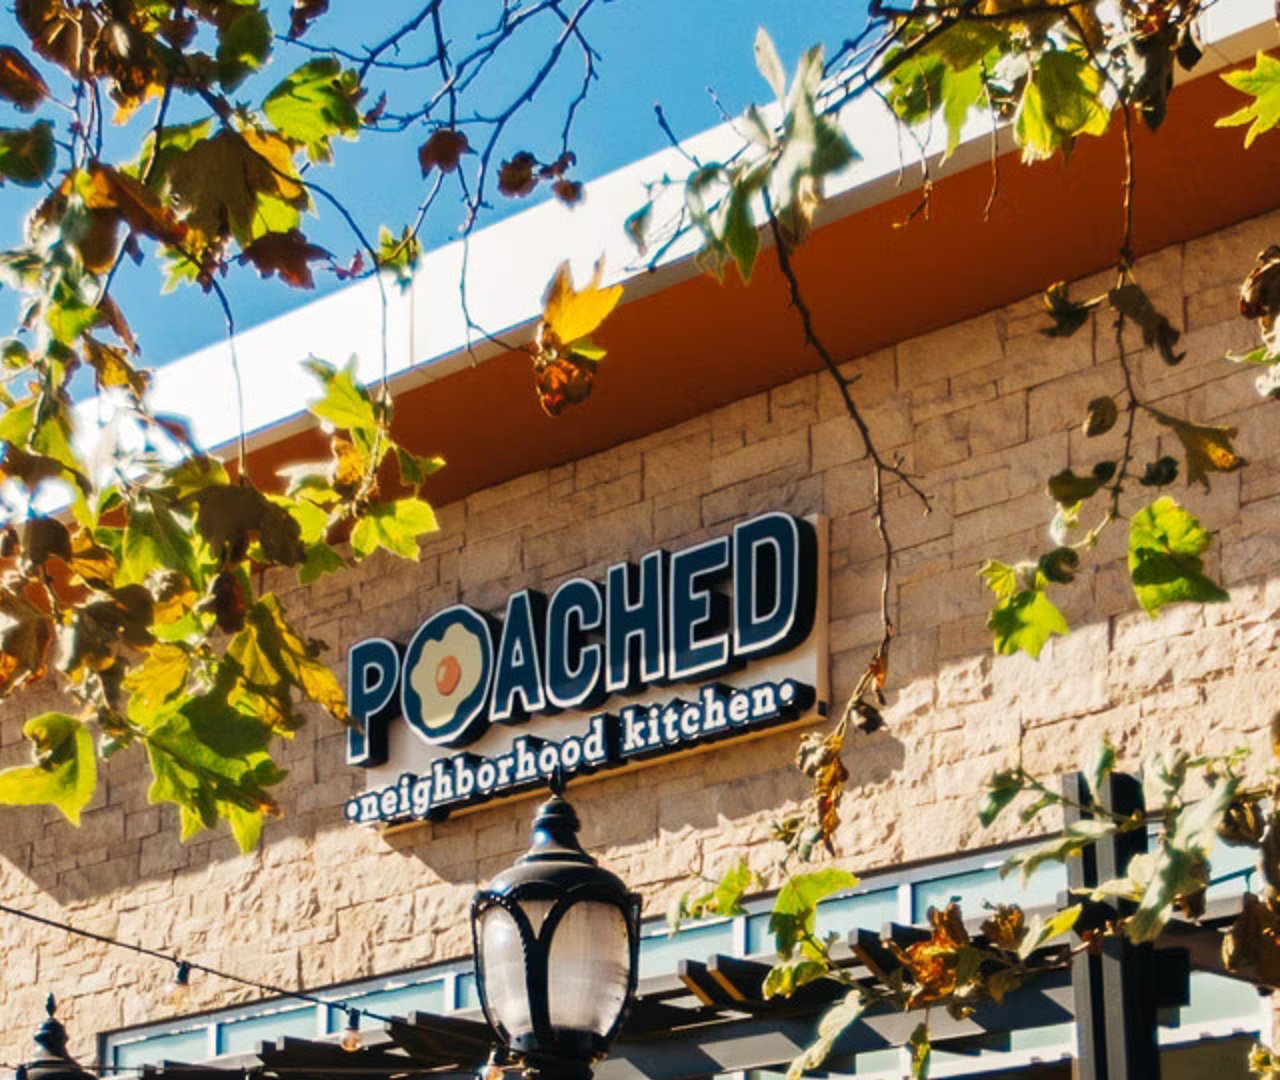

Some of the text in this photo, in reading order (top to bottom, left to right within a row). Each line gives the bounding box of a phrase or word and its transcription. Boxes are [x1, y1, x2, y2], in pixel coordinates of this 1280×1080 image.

[346, 511, 802, 767] POACHED
[357, 687, 780, 822] neighborhood kitchen
